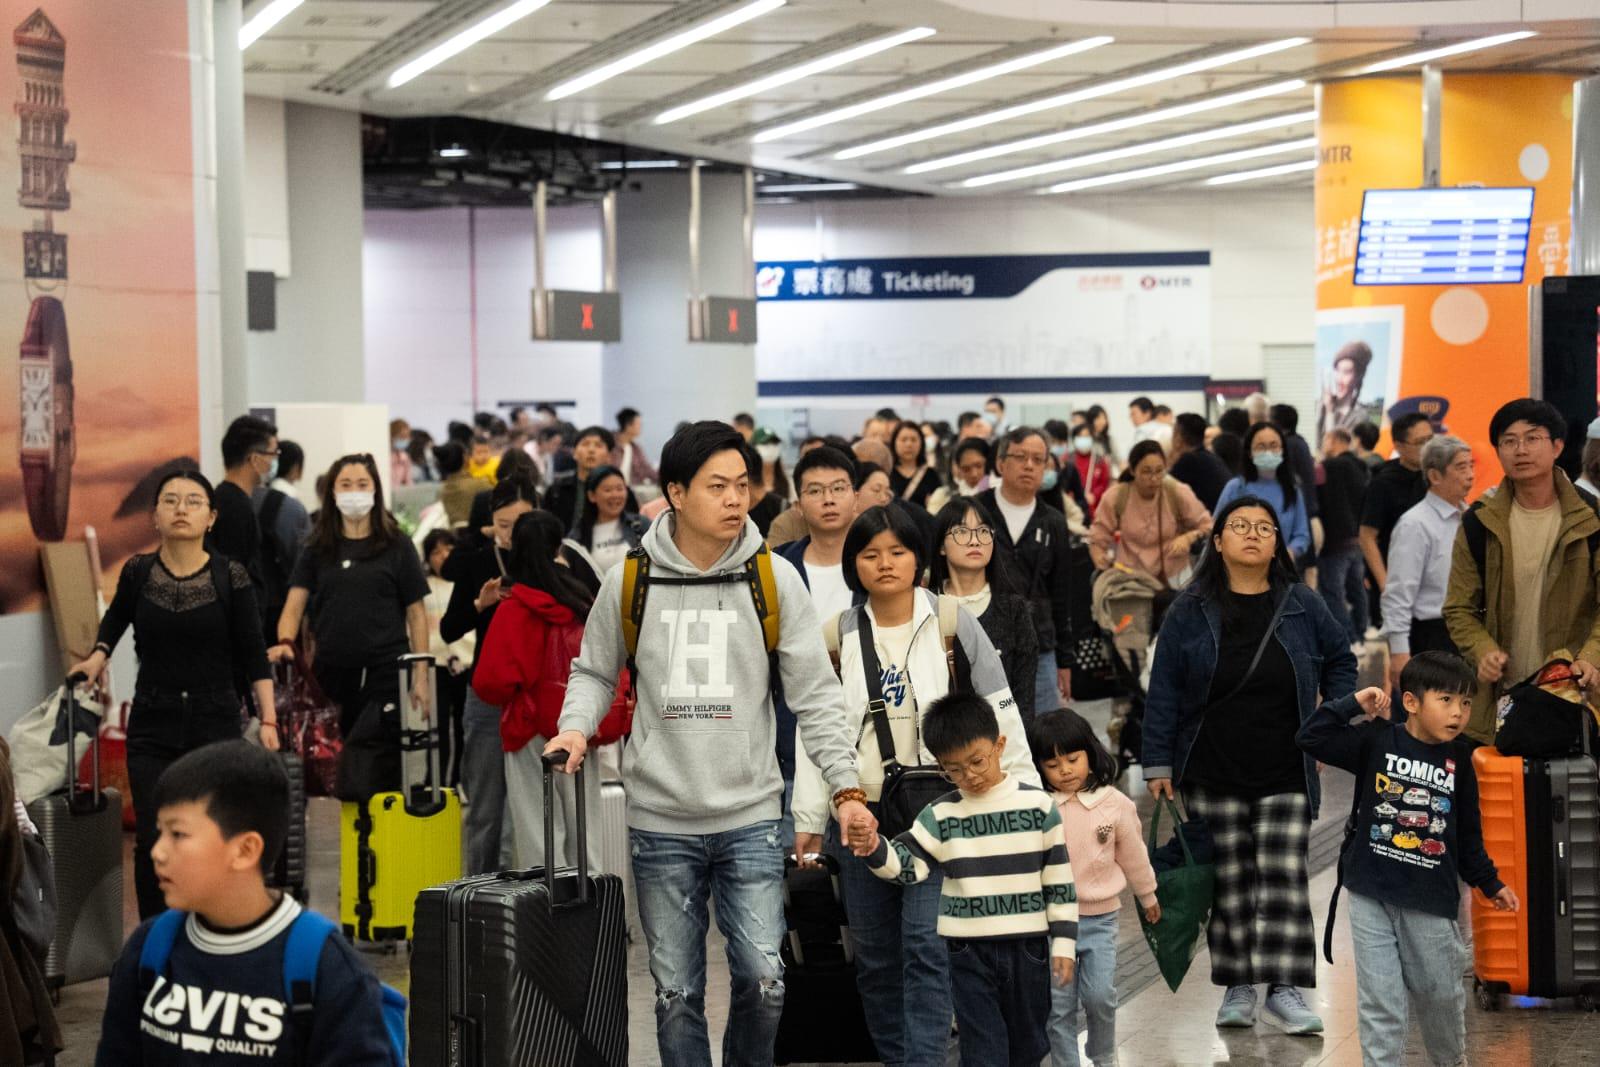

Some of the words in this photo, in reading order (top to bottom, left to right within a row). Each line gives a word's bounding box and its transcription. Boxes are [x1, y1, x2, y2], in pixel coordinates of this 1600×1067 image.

[881, 269, 975, 295] Ticketing
[660, 609, 738, 698] H
[662, 704, 692, 713] OMMY
[694, 704, 733, 713] HILFIGER
[1385, 753, 1455, 793] TOMICA
[215, 1038, 277, 1057] QUALITY
